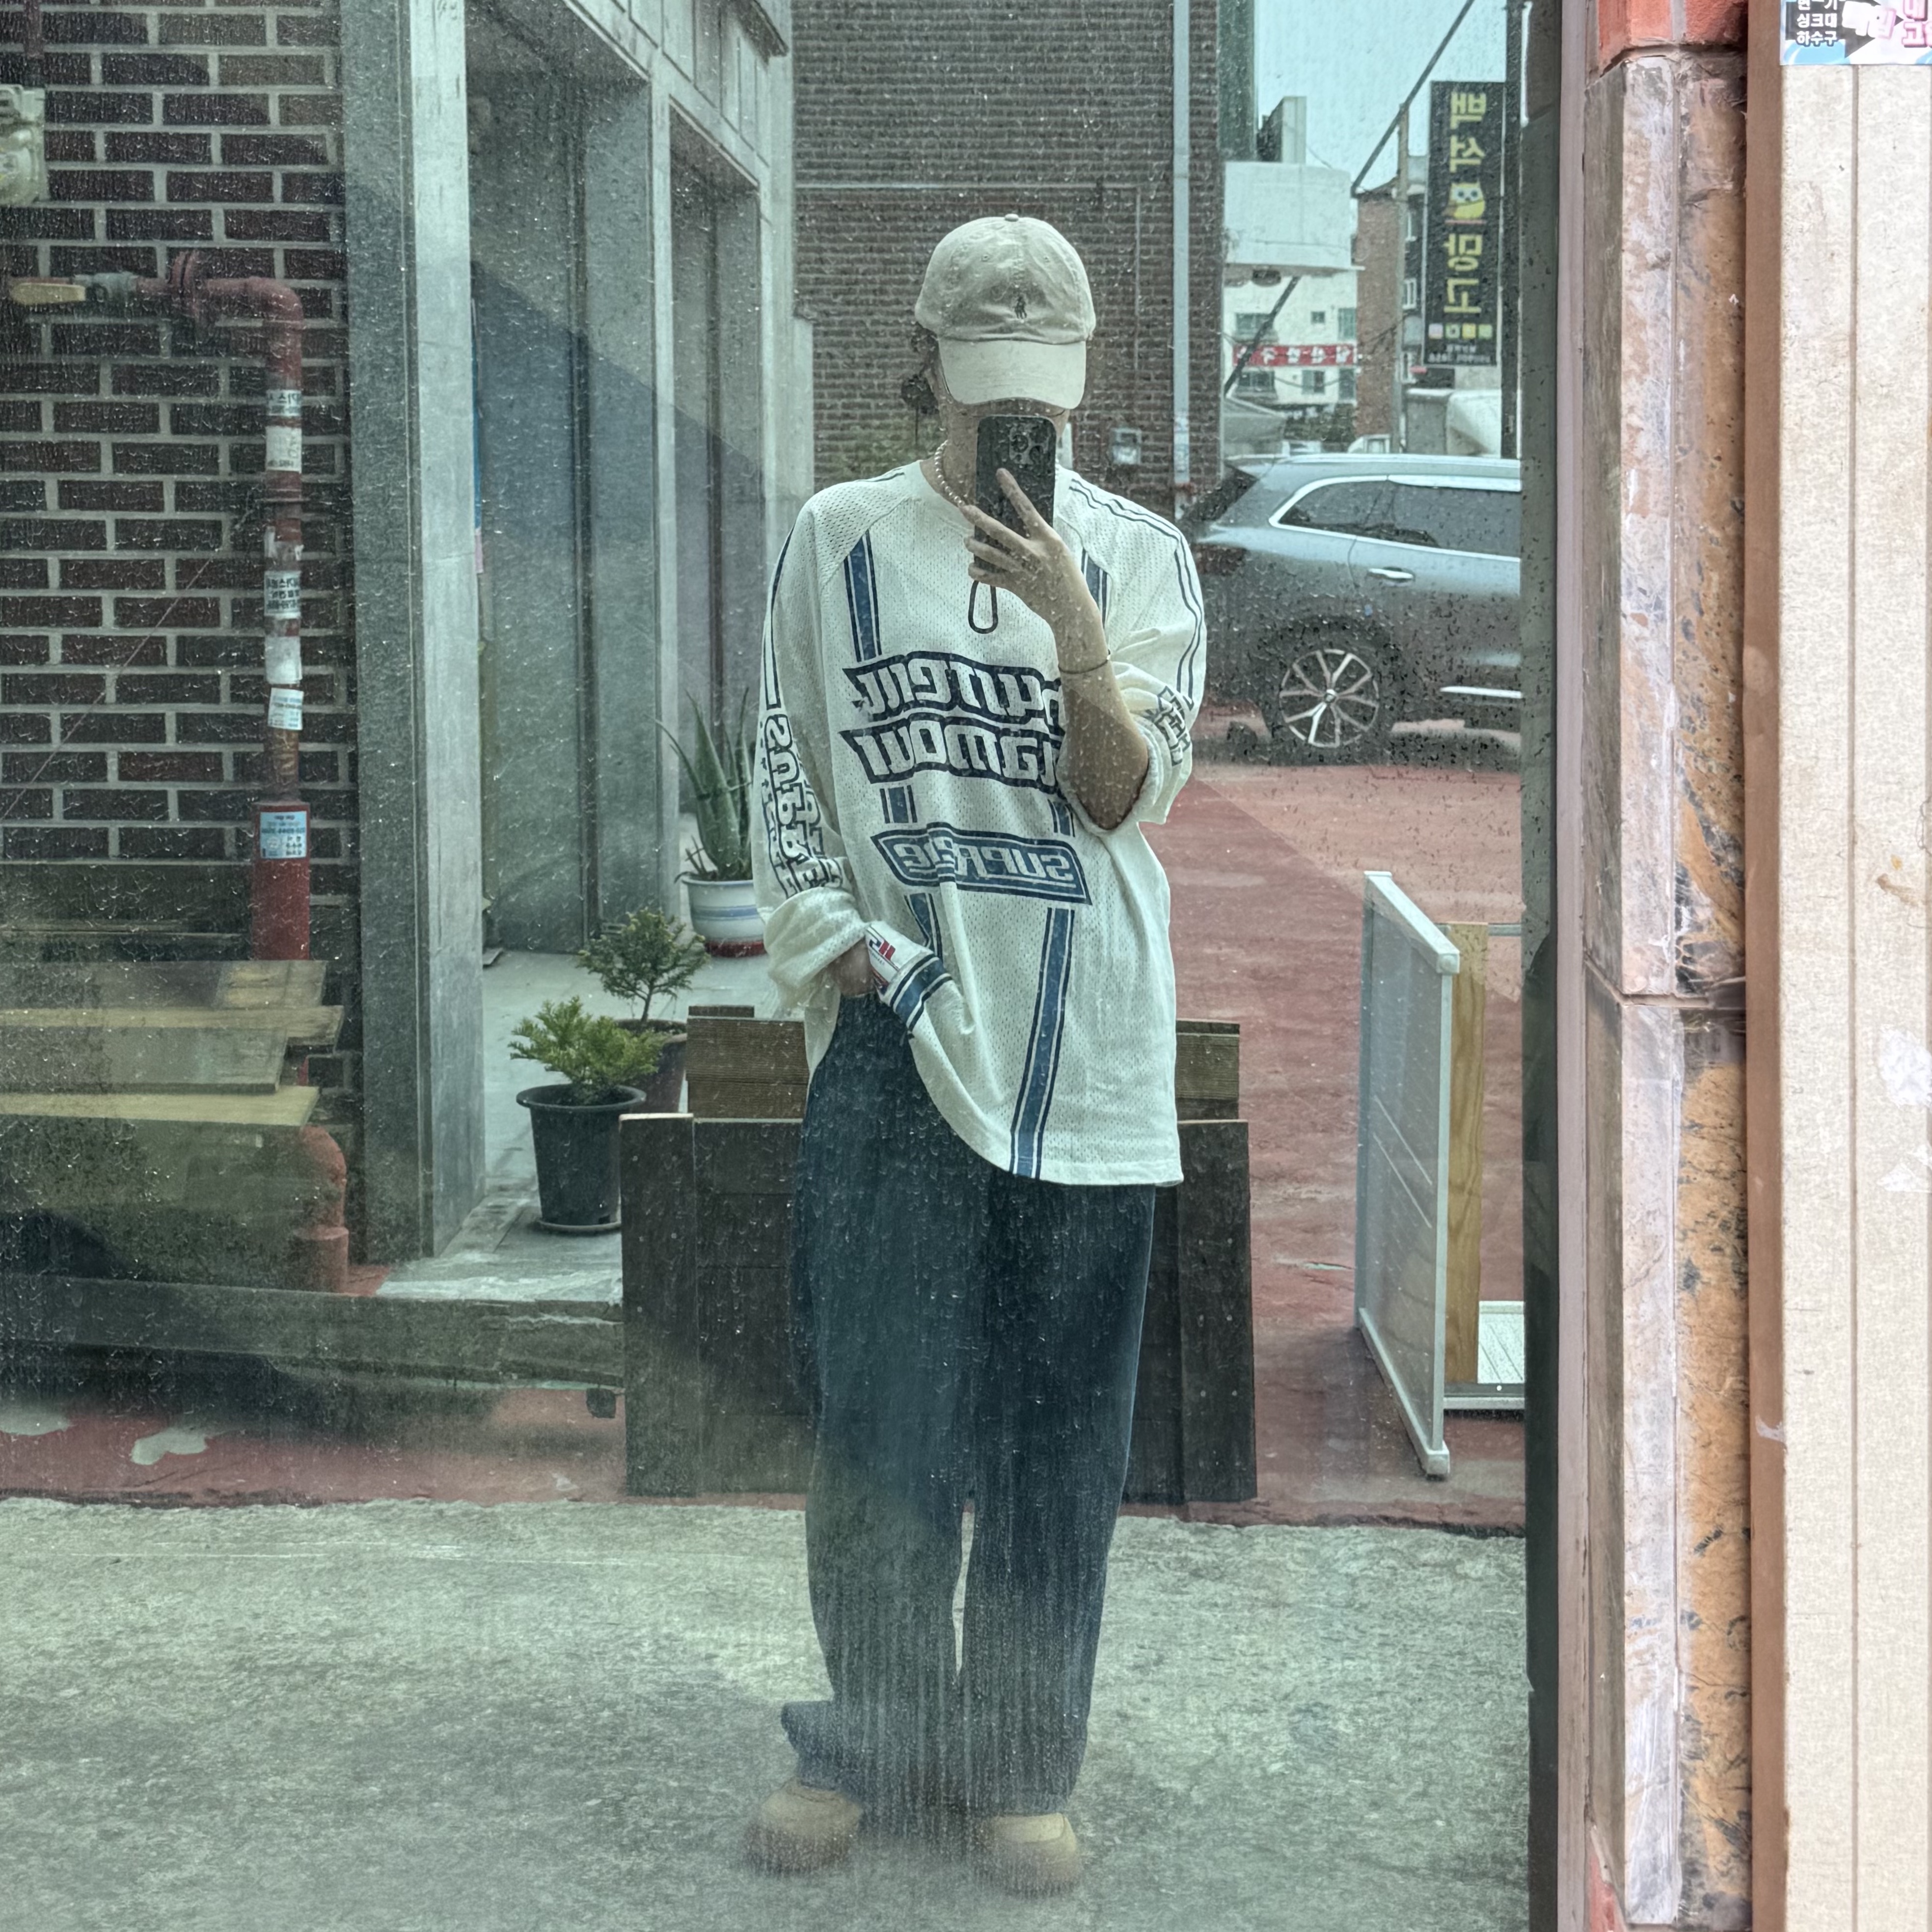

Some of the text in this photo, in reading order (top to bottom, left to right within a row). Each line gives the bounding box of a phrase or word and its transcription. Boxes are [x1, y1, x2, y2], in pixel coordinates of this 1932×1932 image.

[1796, 13, 1837, 28] 싱크대
[1796, 30, 1837, 47] 하수구
[1902, 22, 1932, 48] 고
